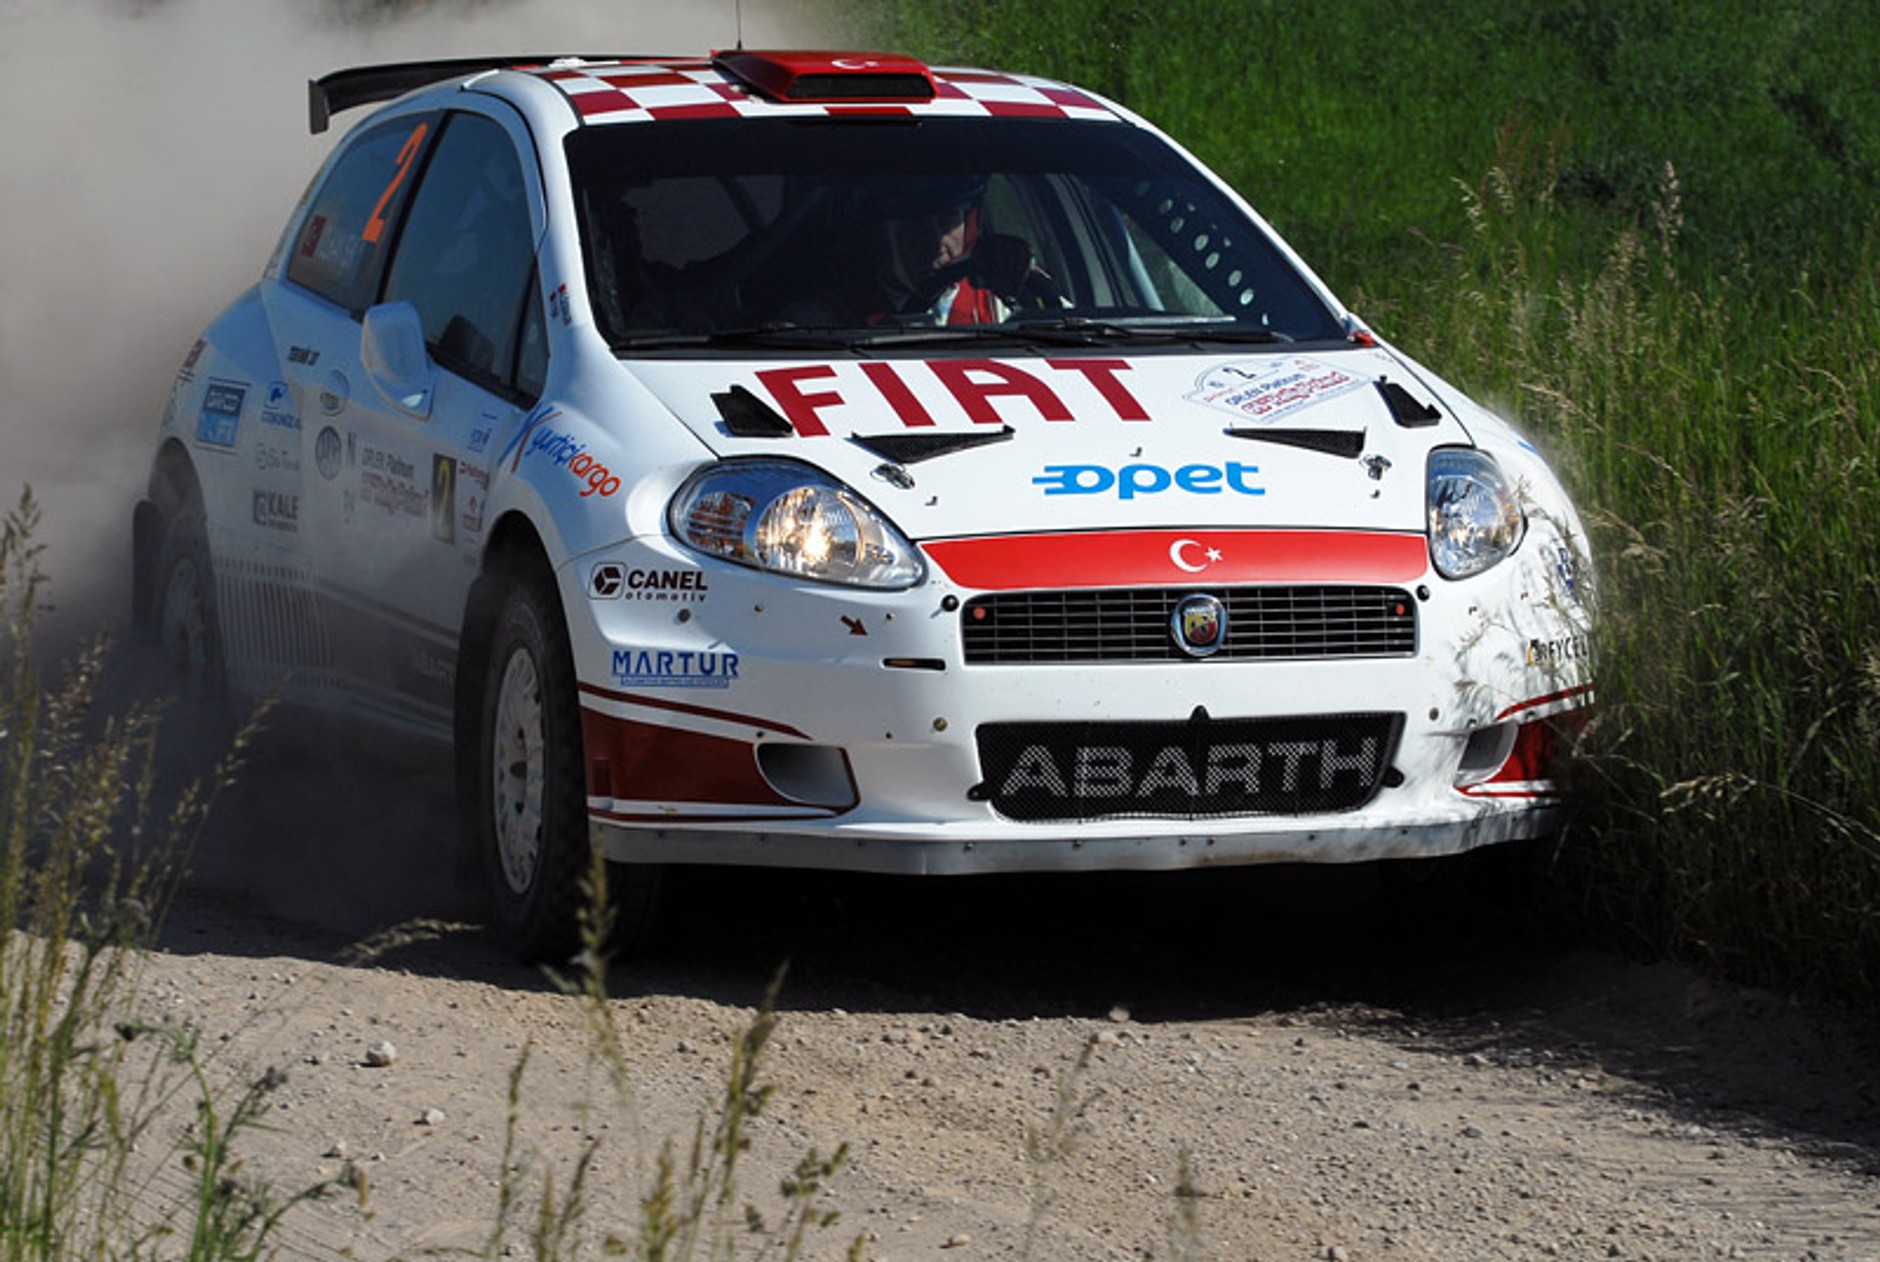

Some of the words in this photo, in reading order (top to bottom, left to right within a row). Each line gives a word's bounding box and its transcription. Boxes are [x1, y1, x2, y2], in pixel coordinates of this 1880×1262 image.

[362, 123, 427, 243] 2
[754, 358, 1152, 438] FIAT
[1032, 461, 1266, 500] opet
[268, 490, 299, 519] KALE
[627, 569, 708, 591] CANEL
[612, 651, 739, 678] MARTUR
[1002, 737, 1378, 798] ABARTH
